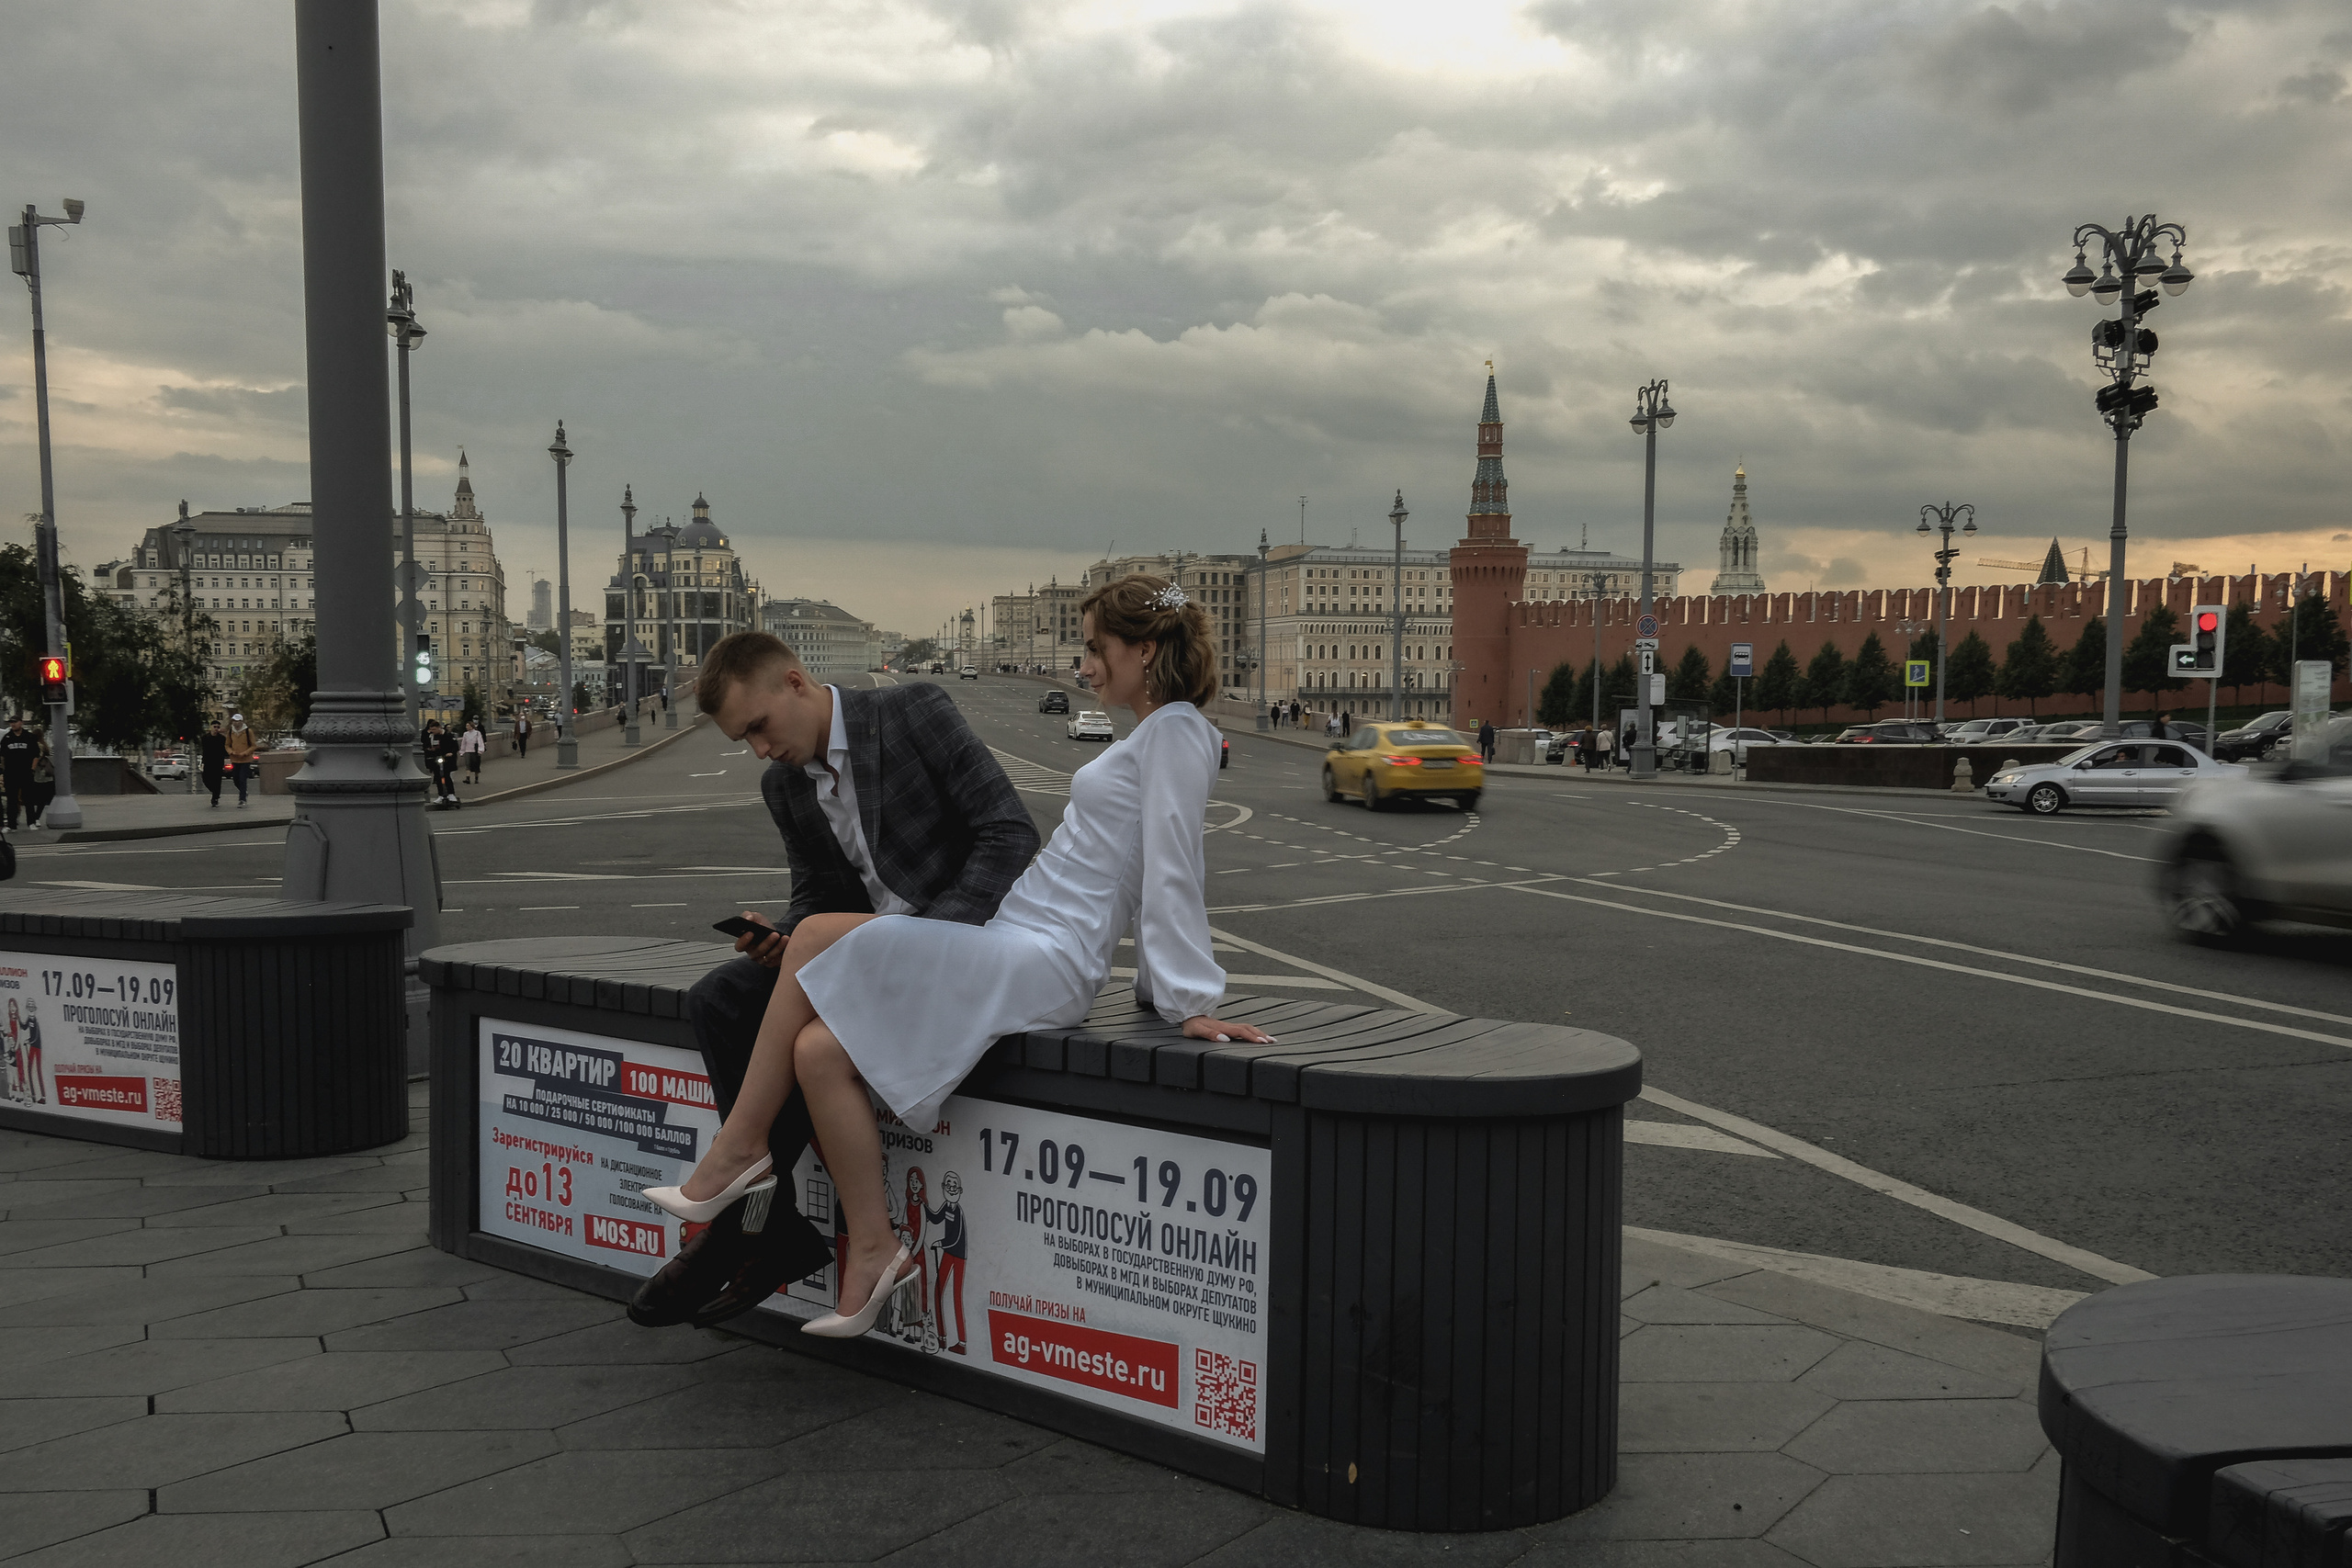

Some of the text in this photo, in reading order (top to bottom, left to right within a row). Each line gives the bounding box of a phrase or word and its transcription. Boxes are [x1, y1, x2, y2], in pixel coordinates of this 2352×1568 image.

[63, 1004, 175, 1033] ПРОГОЛОСУЙ ОНЛАЙН
[499, 1040, 616, 1087] 20 КВАРТИР
[62, 1085, 141, 1105] ag-vmeste.ru
[535, 1089, 656, 1123] ПОДАРОЧНЫЕ СЕРТИФИКАТЫ
[630, 1070, 717, 1105] 100 МАШИ
[506, 1097, 517, 1110] НА
[519, 1100, 528, 1112] 10
[529, 1101, 544, 1116] 000
[551, 1106, 561, 1120] 25
[562, 1108, 578, 1122] 000
[584, 1112, 595, 1127] 50
[597, 1115, 613, 1130] 000
[636, 1123, 653, 1138] 000
[654, 1127, 692, 1146] БАЛЛОВ
[492, 1126, 594, 1166] Зарегистрируйся
[505, 1162, 572, 1207] до 13
[600, 1156, 662, 1181] НА ДИСТАНЦИОННОЕ
[979, 1128, 1258, 1223] 17.09—19.09
[505, 1201, 572, 1236] СЕНТЯБРЯ
[609, 1193, 662, 1216] ГОЛОСОВАНИЕ НА
[593, 1216, 659, 1255] MOS.RU
[1016, 1190, 1257, 1275] ПРОГОЛОСУЙ ОНЛАЙН
[1044, 1232, 1258, 1297] НА ВЫБОРАХ В ГОСУДАРСТВЕННУЮ ДУМУ РФ,
[1053, 1252, 1257, 1314] ДОВЫБОРАХ В МГД И ВЫБОРАХ ДЕПУТАТОВ
[989, 1291, 1086, 1324] ПОЛУЧАЙ ПРИЗЫ НА
[1076, 1276, 1257, 1335] В МУНИЦИПАЛЬНОМ ОКРУГЕ ЩУКИНО
[1003, 1332, 1165, 1393] ag-vmeste.ru
